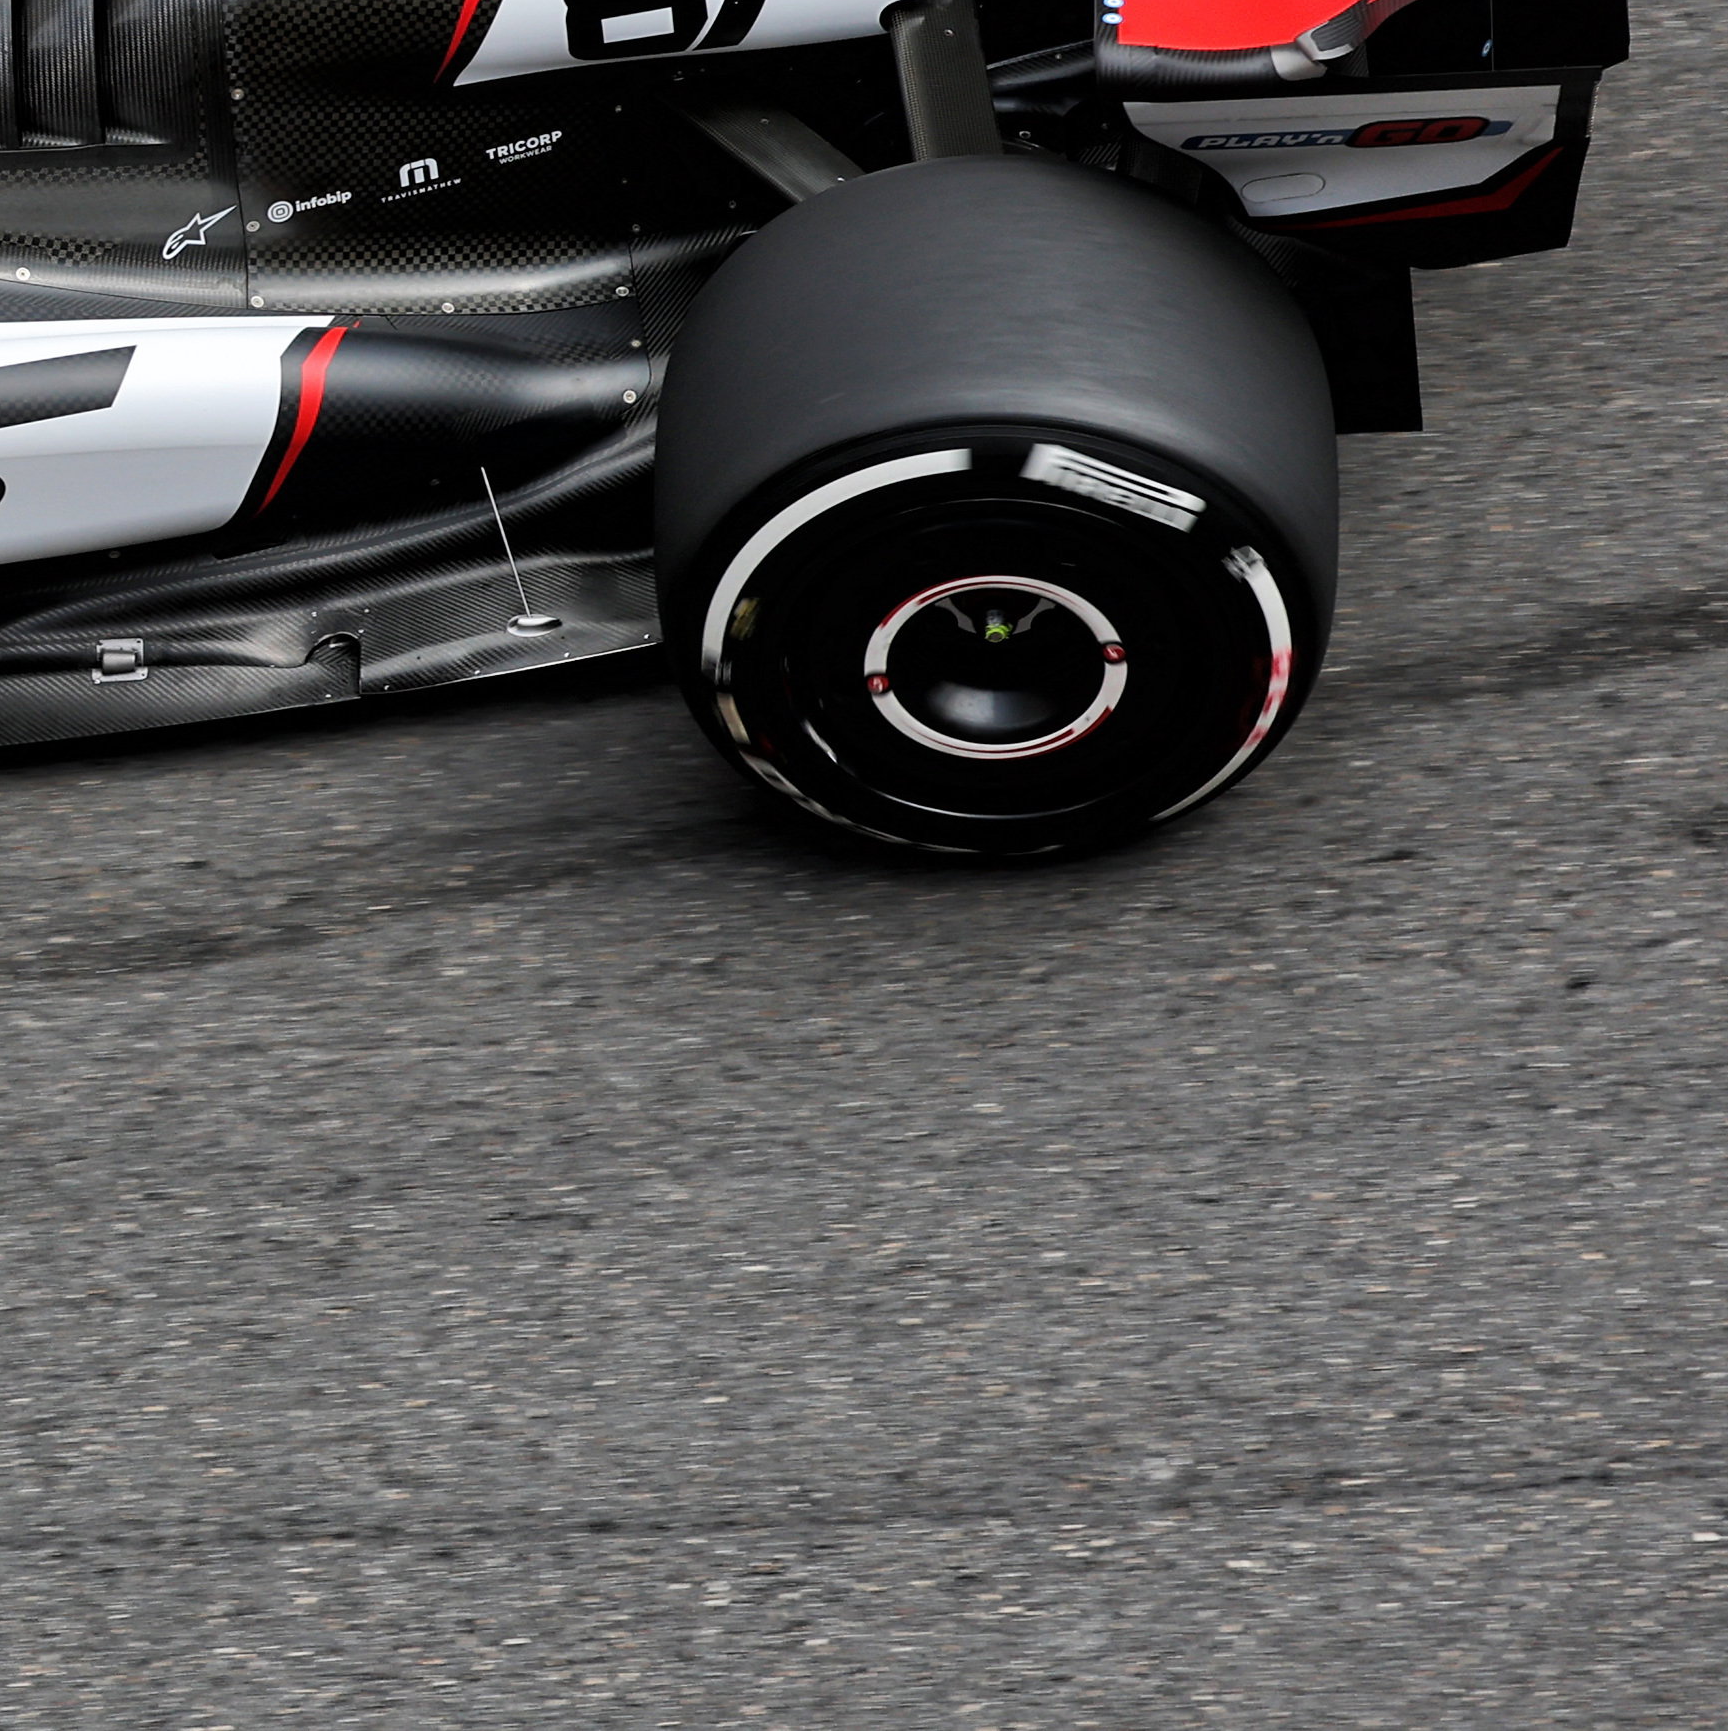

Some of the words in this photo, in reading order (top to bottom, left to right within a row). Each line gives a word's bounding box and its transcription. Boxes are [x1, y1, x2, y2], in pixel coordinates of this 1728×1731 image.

[485, 130, 563, 160] TRICORP
[1351, 117, 1487, 147] GO
[498, 145, 553, 165] WORKWEAR
[295, 190, 352, 213] infobip
[380, 177, 463, 205] TRAVISMATHEW
